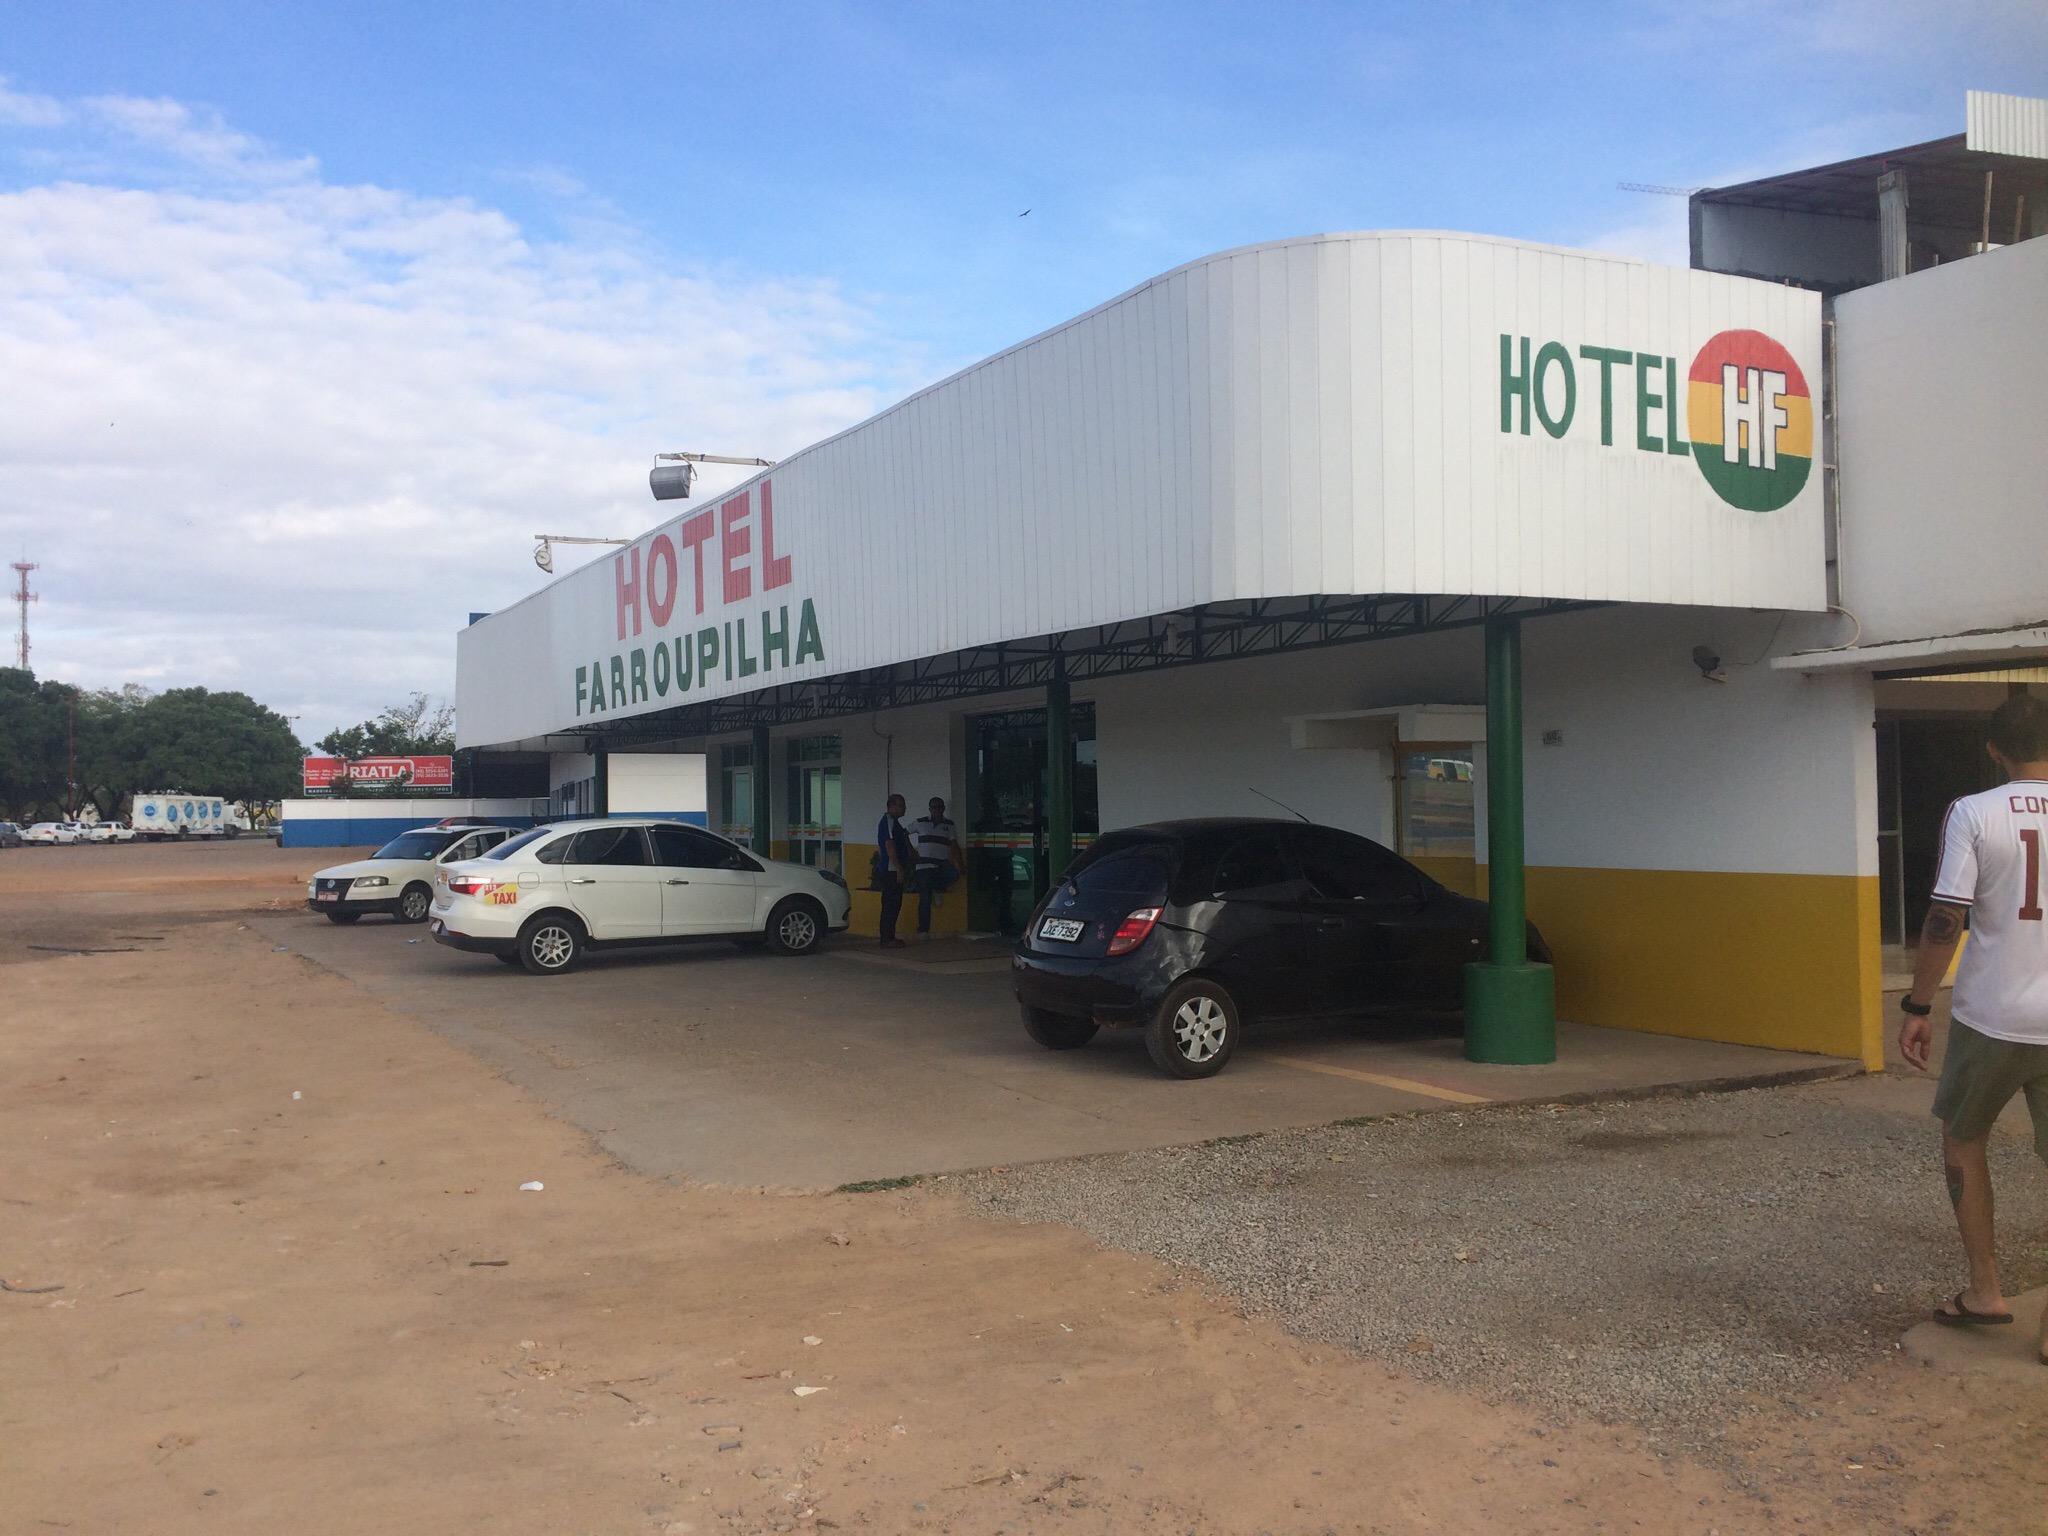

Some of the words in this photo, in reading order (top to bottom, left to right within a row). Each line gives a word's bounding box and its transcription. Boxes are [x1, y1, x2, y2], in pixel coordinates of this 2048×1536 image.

[1500, 334, 1690, 456] HOTEL
[1722, 364, 1788, 471] HF
[615, 479, 792, 641] HOTEL
[575, 598, 825, 716] FARROUPILHA
[493, 892, 517, 904] TAXI
